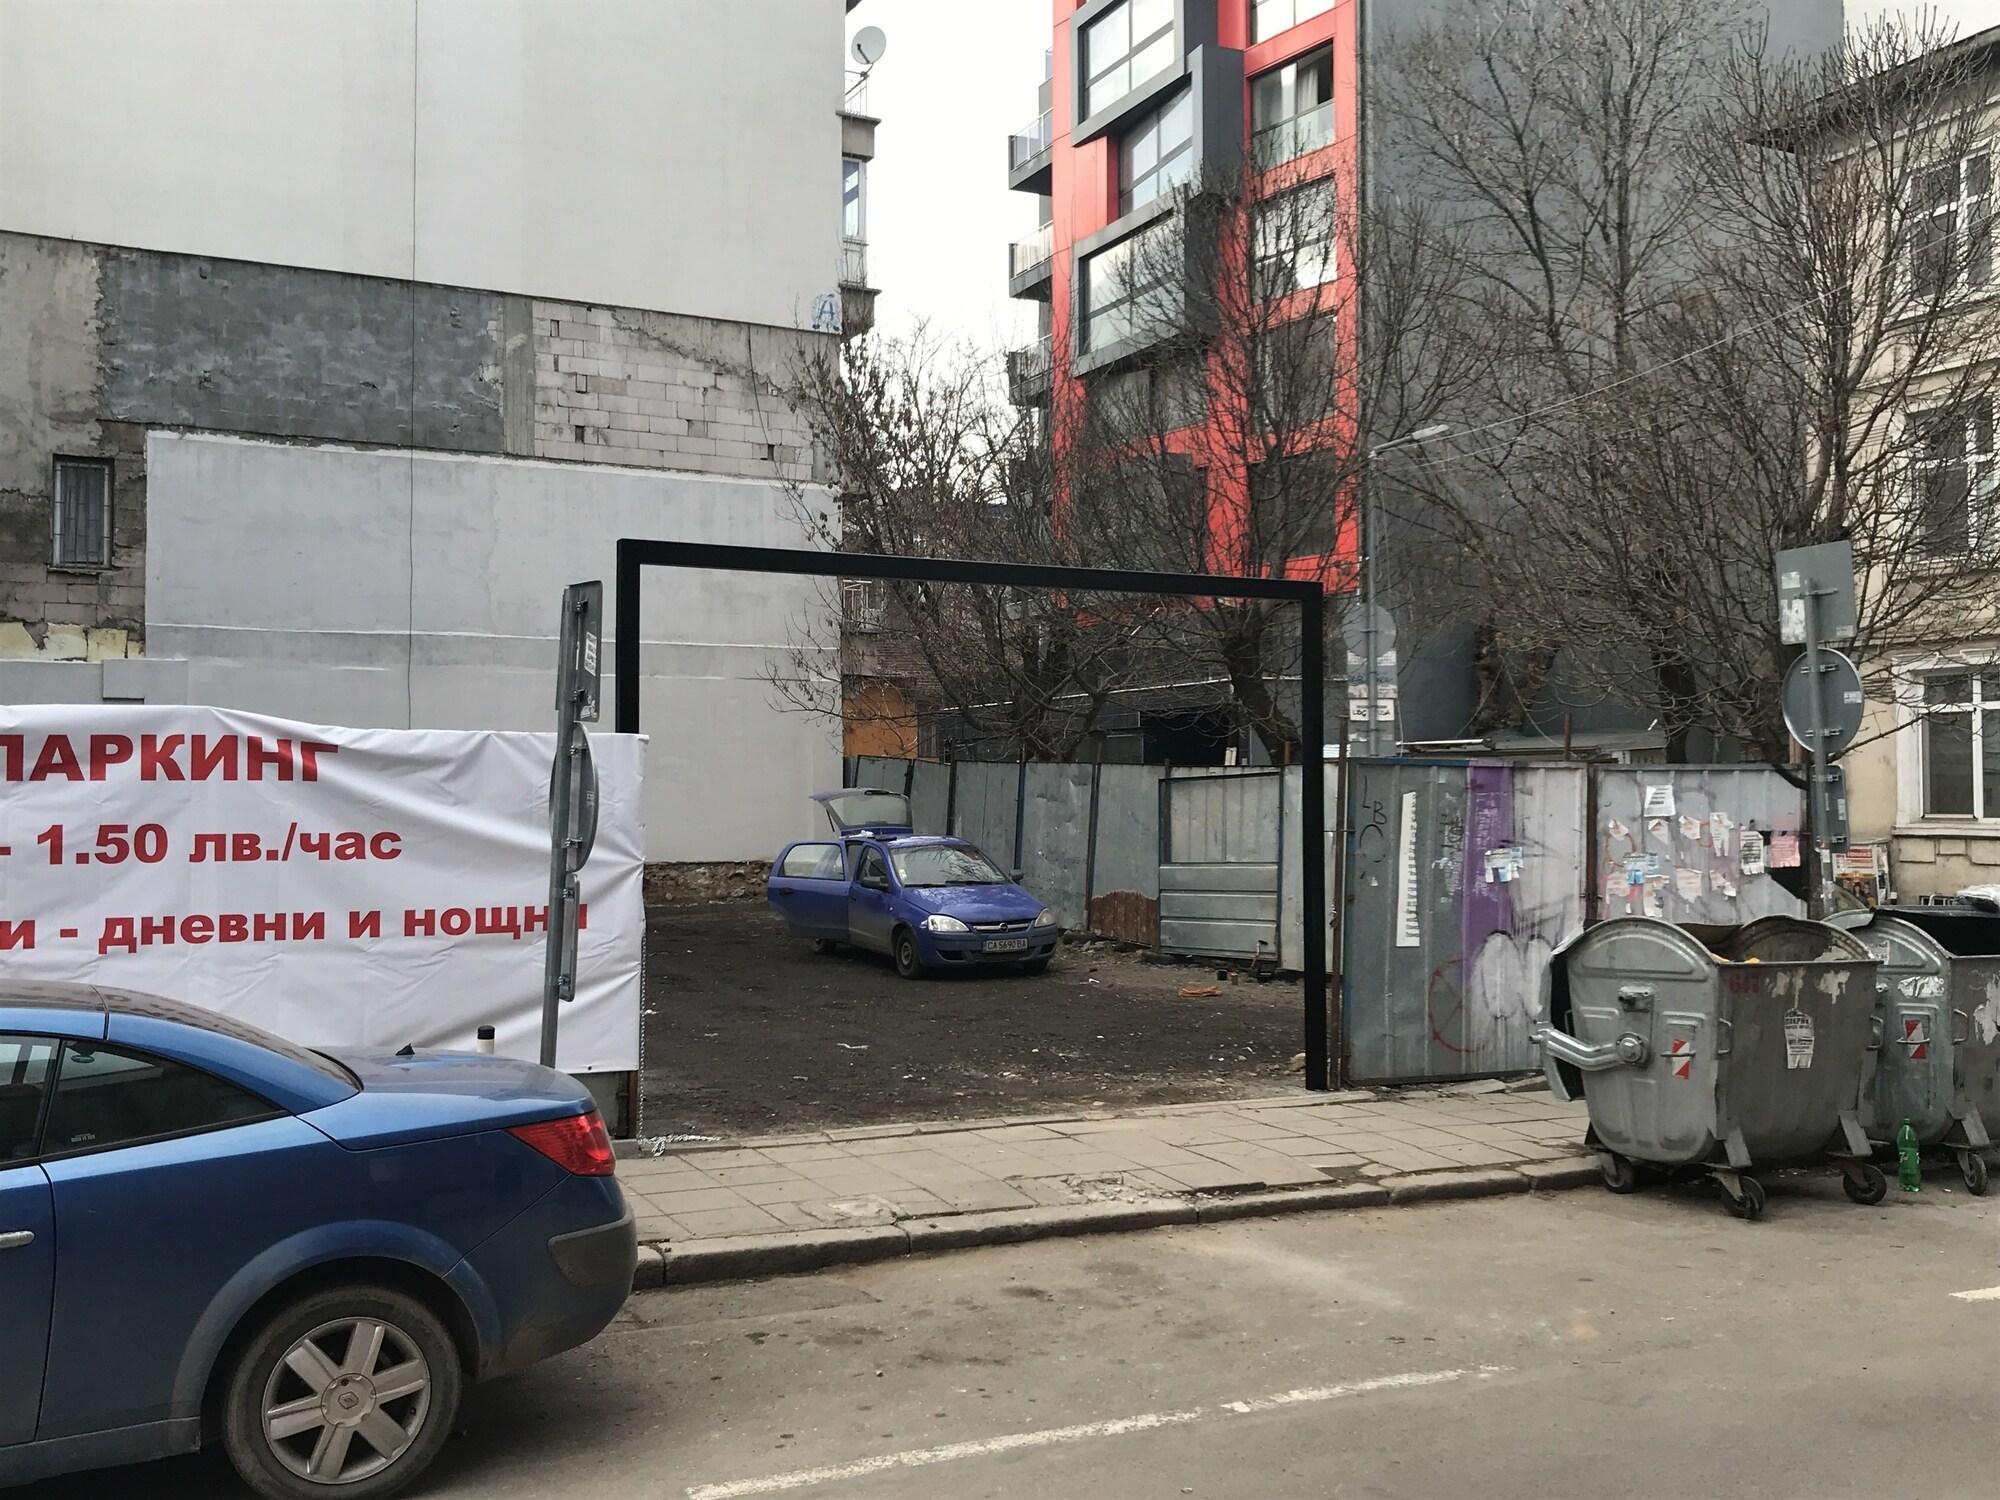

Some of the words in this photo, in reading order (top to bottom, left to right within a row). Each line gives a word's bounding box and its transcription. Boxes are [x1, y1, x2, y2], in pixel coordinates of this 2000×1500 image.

[0, 734, 337, 782] ПАРКИНГ
[37, 824, 169, 865] 1.50
[190, 822, 402, 864] лв./час
[98, 911, 326, 956] дневни
[349, 911, 381, 939] и
[403, 903, 588, 940] нощн
